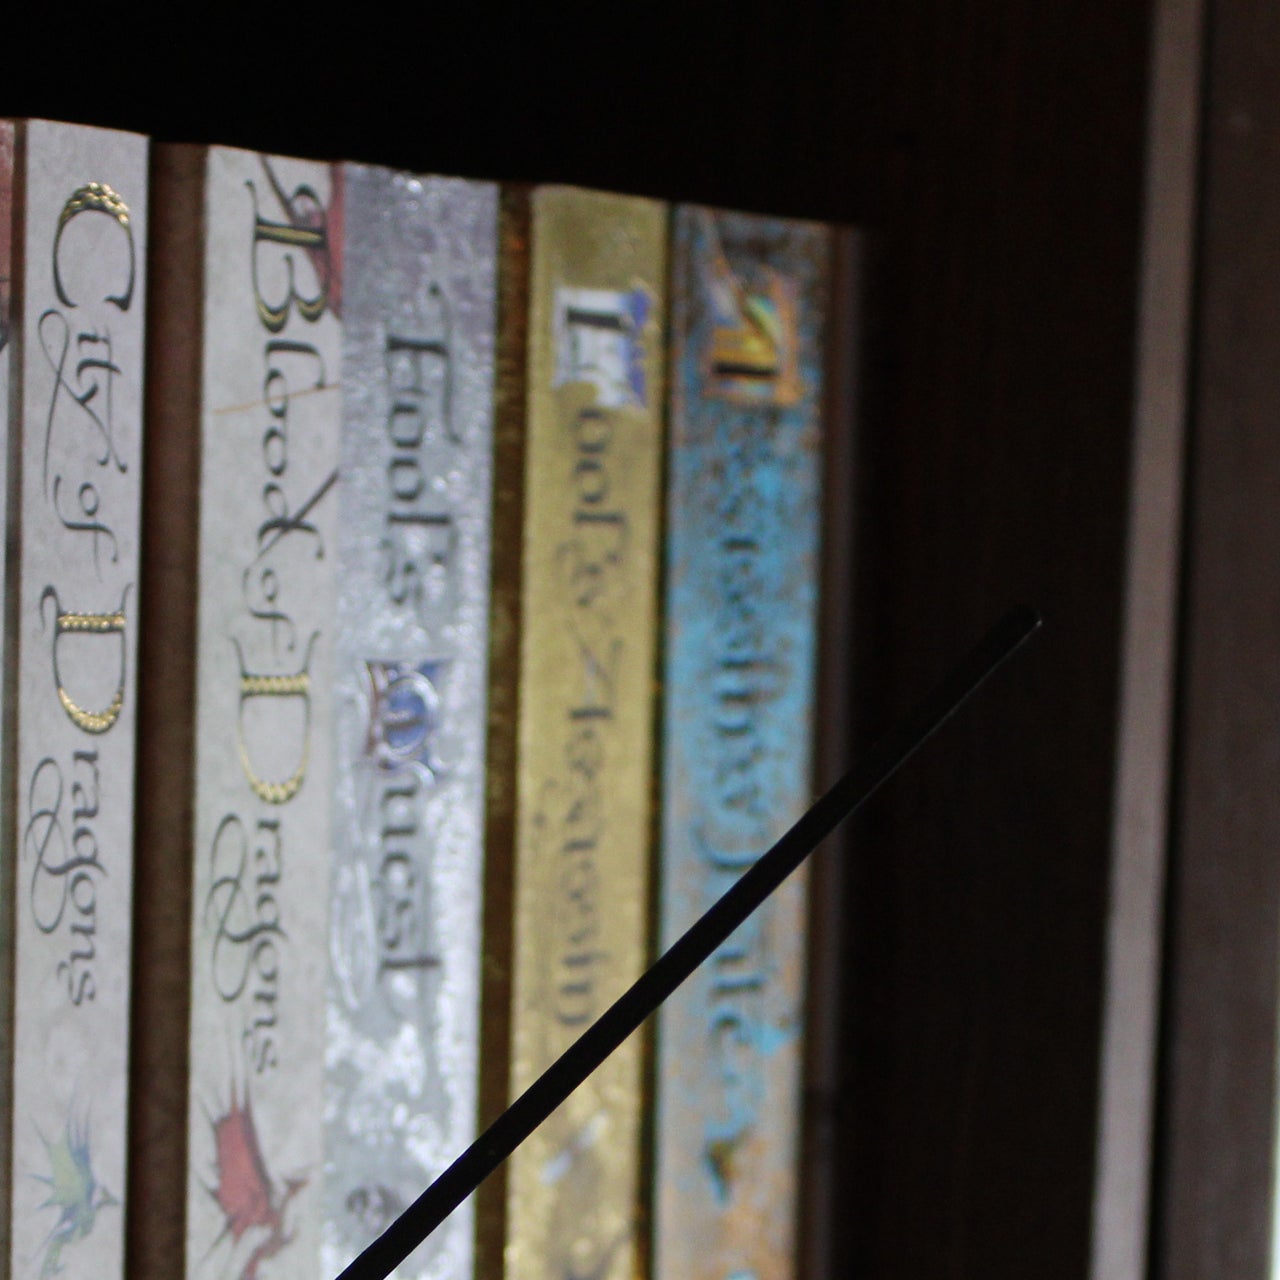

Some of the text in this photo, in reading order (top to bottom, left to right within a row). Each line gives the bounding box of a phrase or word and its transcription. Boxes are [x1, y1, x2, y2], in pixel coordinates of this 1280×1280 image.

[25, 181, 136, 1007] City of Dragons
[205, 179, 340, 1075] Blood of Dragons
